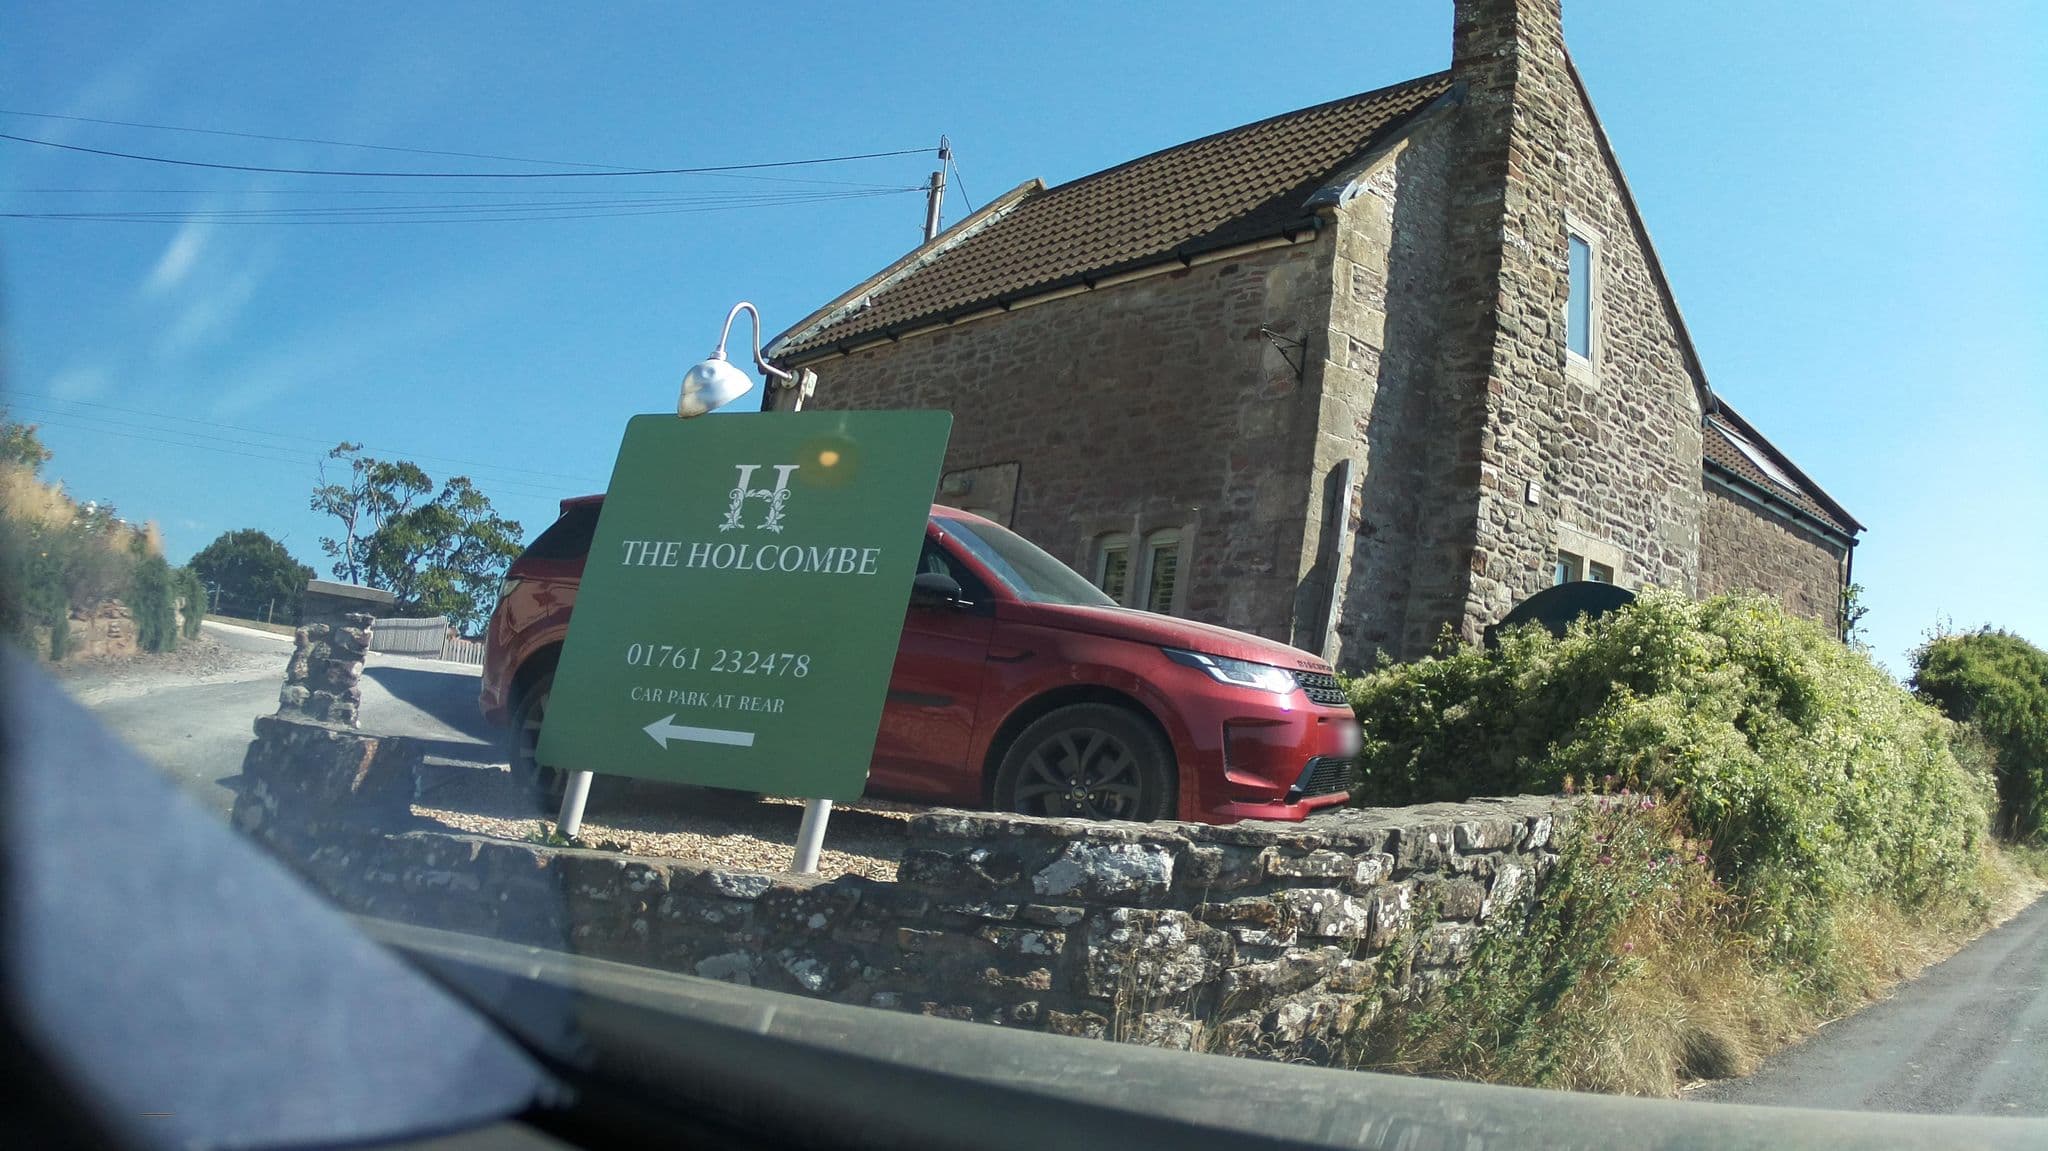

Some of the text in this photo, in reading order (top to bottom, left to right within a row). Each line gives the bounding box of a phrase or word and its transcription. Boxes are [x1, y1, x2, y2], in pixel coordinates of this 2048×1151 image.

[621, 540, 881, 575] THE HOLCOMBE
[626, 643, 811, 678] 01761 232478
[630, 686, 785, 713] CAR PARK AT REAR
